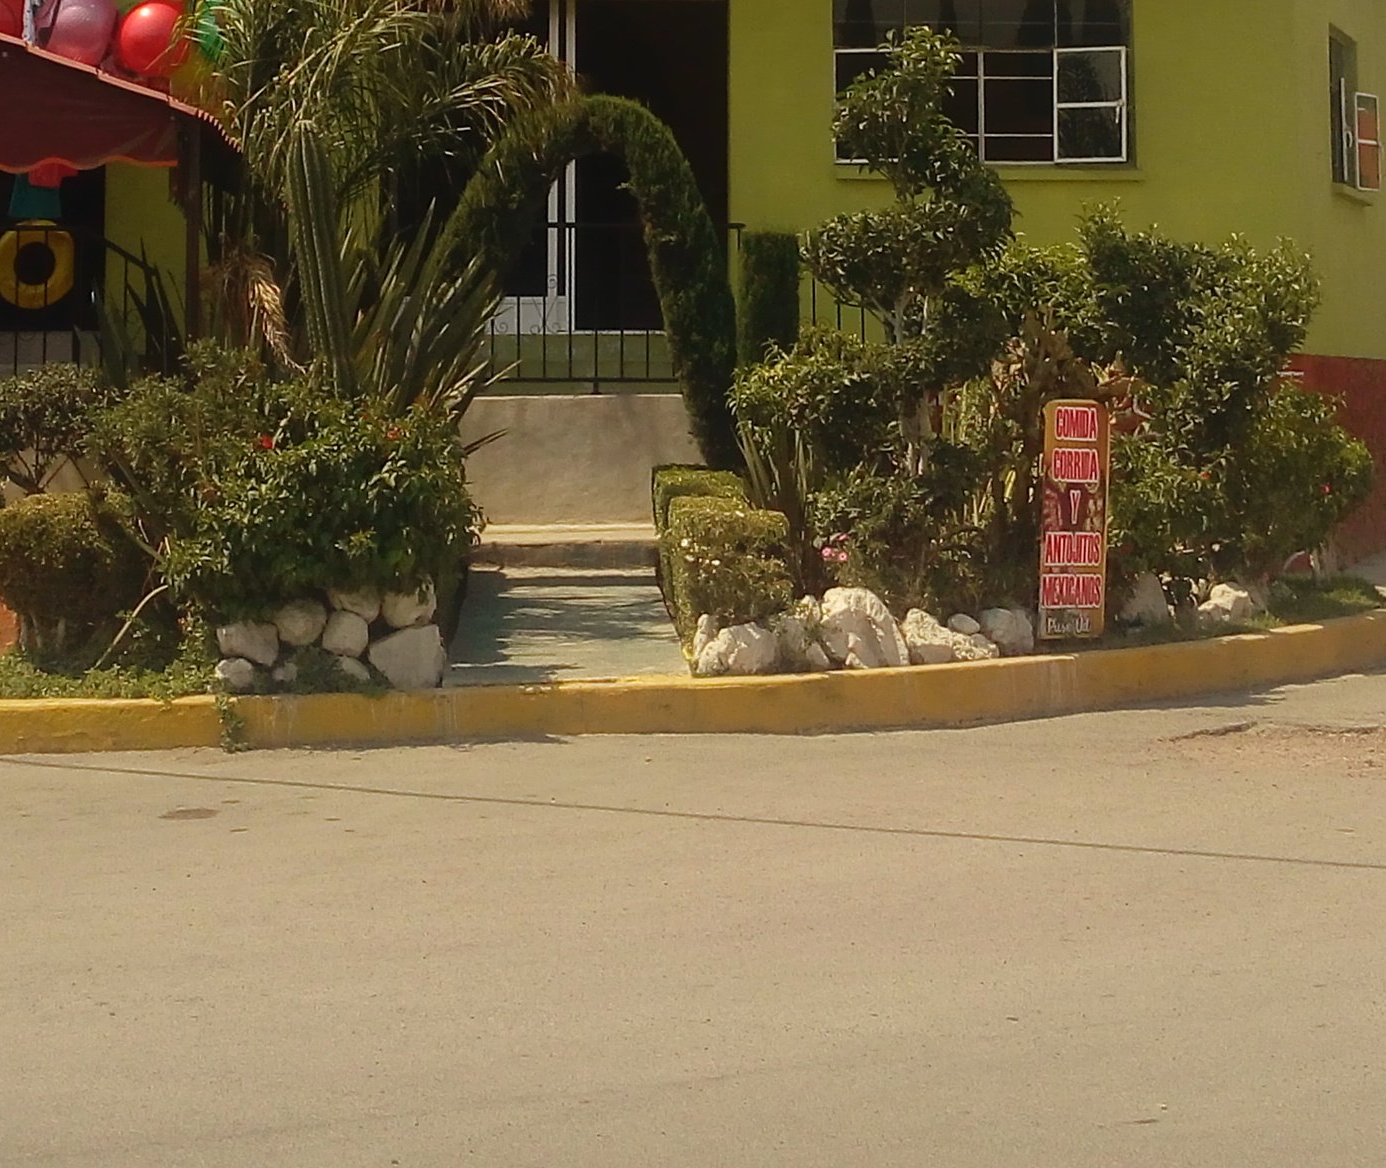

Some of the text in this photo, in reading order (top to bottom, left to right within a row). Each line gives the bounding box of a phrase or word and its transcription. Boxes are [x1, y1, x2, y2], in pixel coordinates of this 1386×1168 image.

[1055, 406, 1098, 441] COMIDA
[1052, 448, 1099, 482] CORRIDA
[1070, 489, 1081, 524] Y
[1044, 532, 1101, 566] ANTOJITOS
[1041, 574, 1102, 609] MEXICANOS
